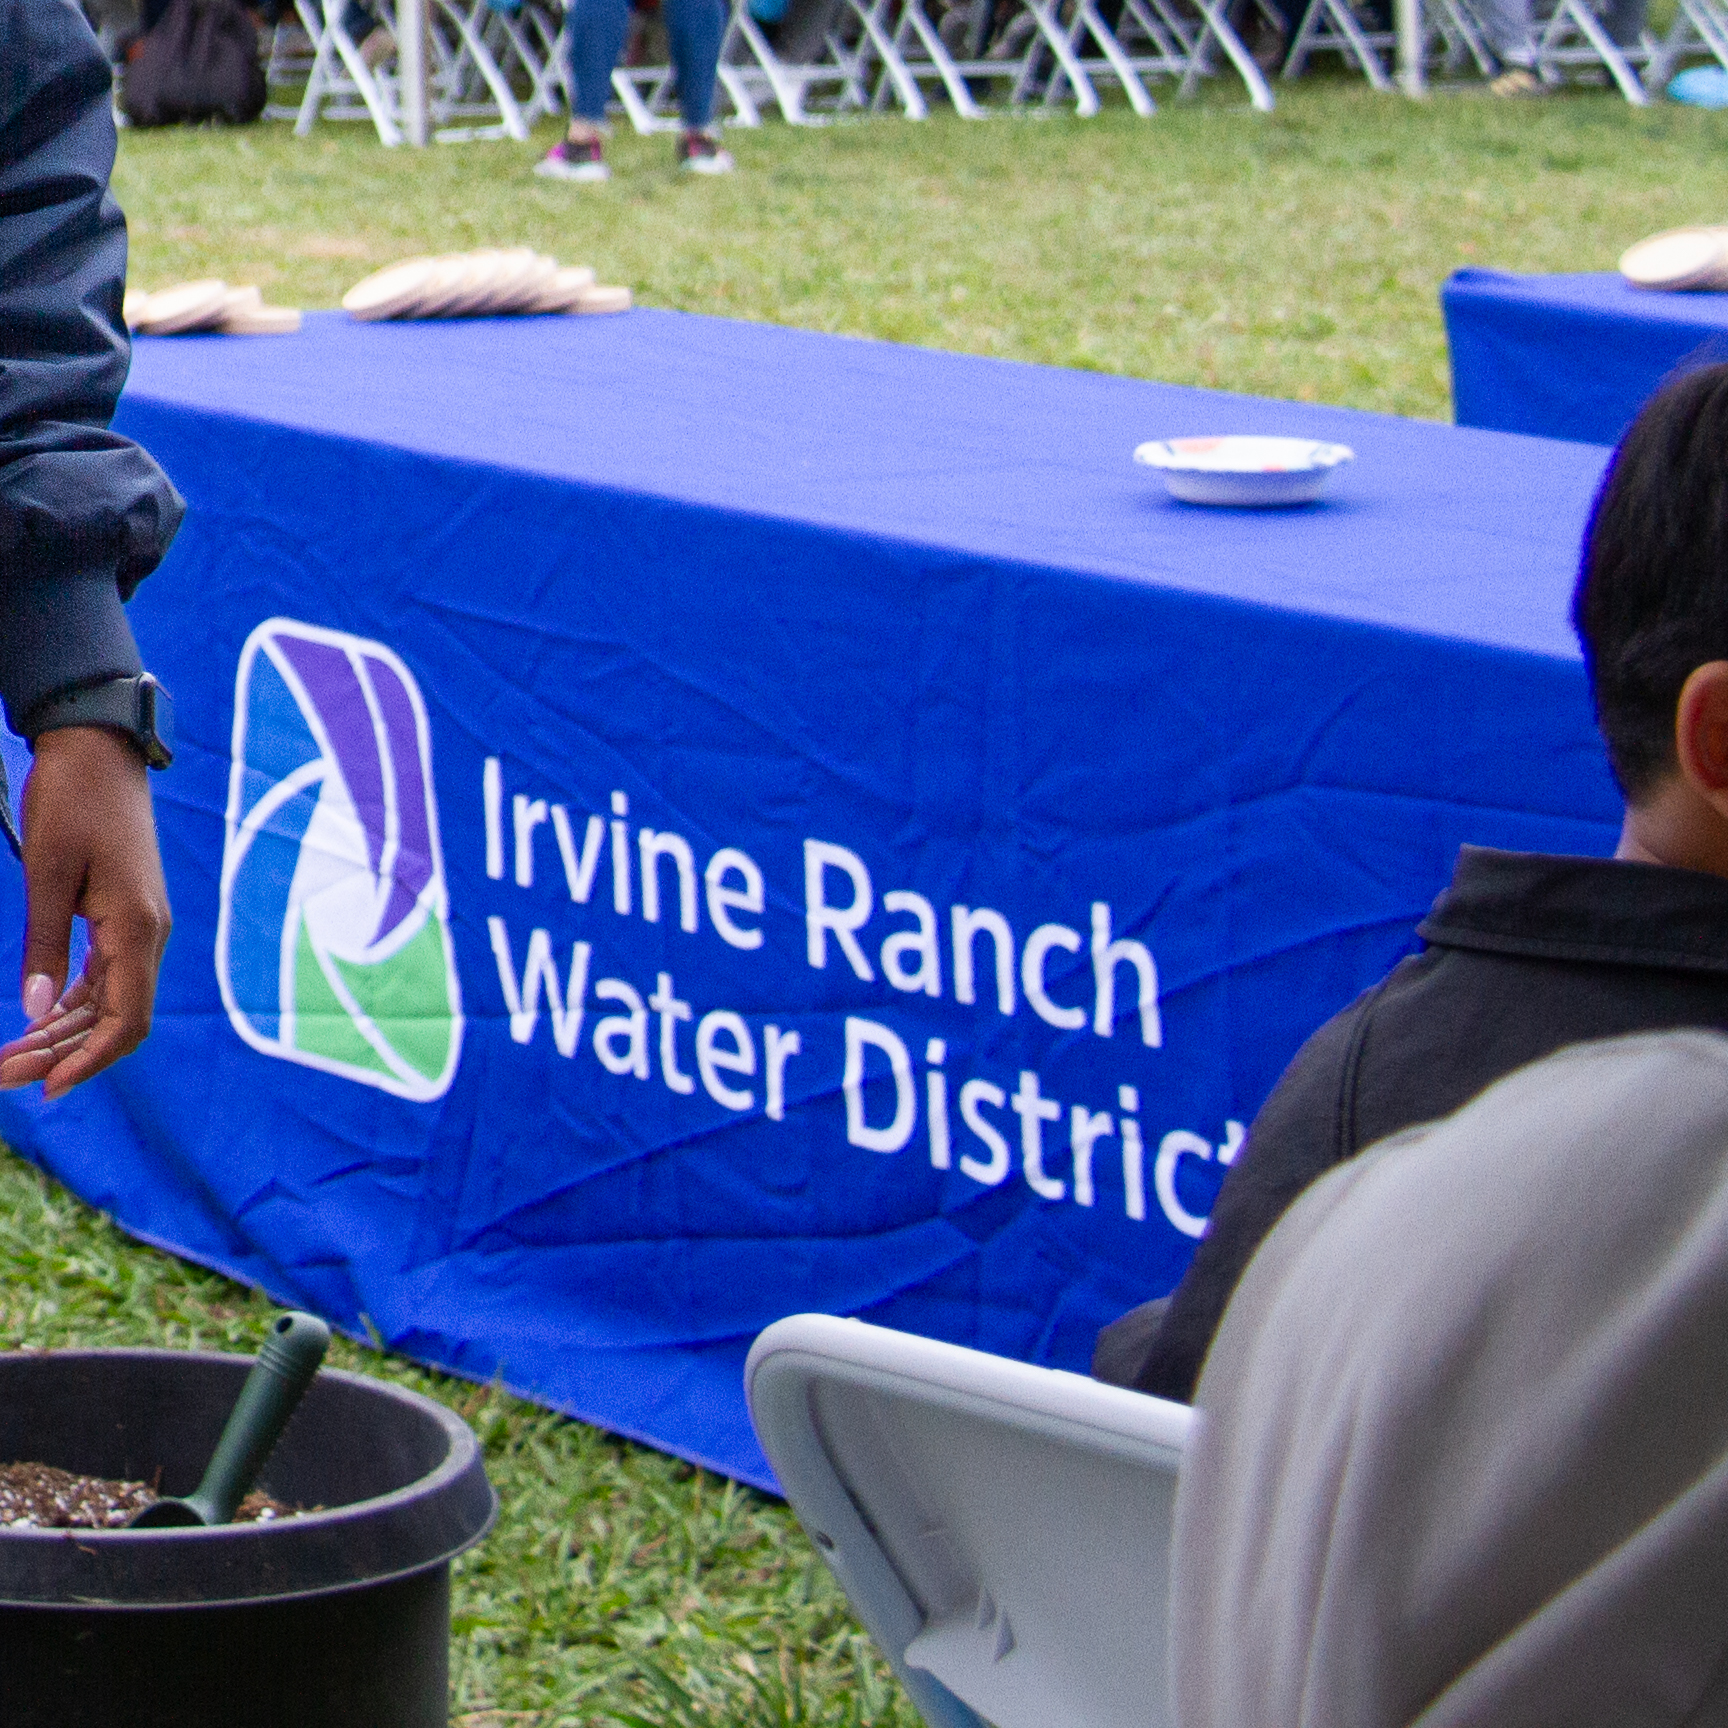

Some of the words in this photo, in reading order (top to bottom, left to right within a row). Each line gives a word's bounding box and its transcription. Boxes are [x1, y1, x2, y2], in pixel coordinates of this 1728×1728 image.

[482, 756, 766, 951] Irvine
[803, 838, 1163, 1049] Ranch
[487, 915, 801, 1122] Water
